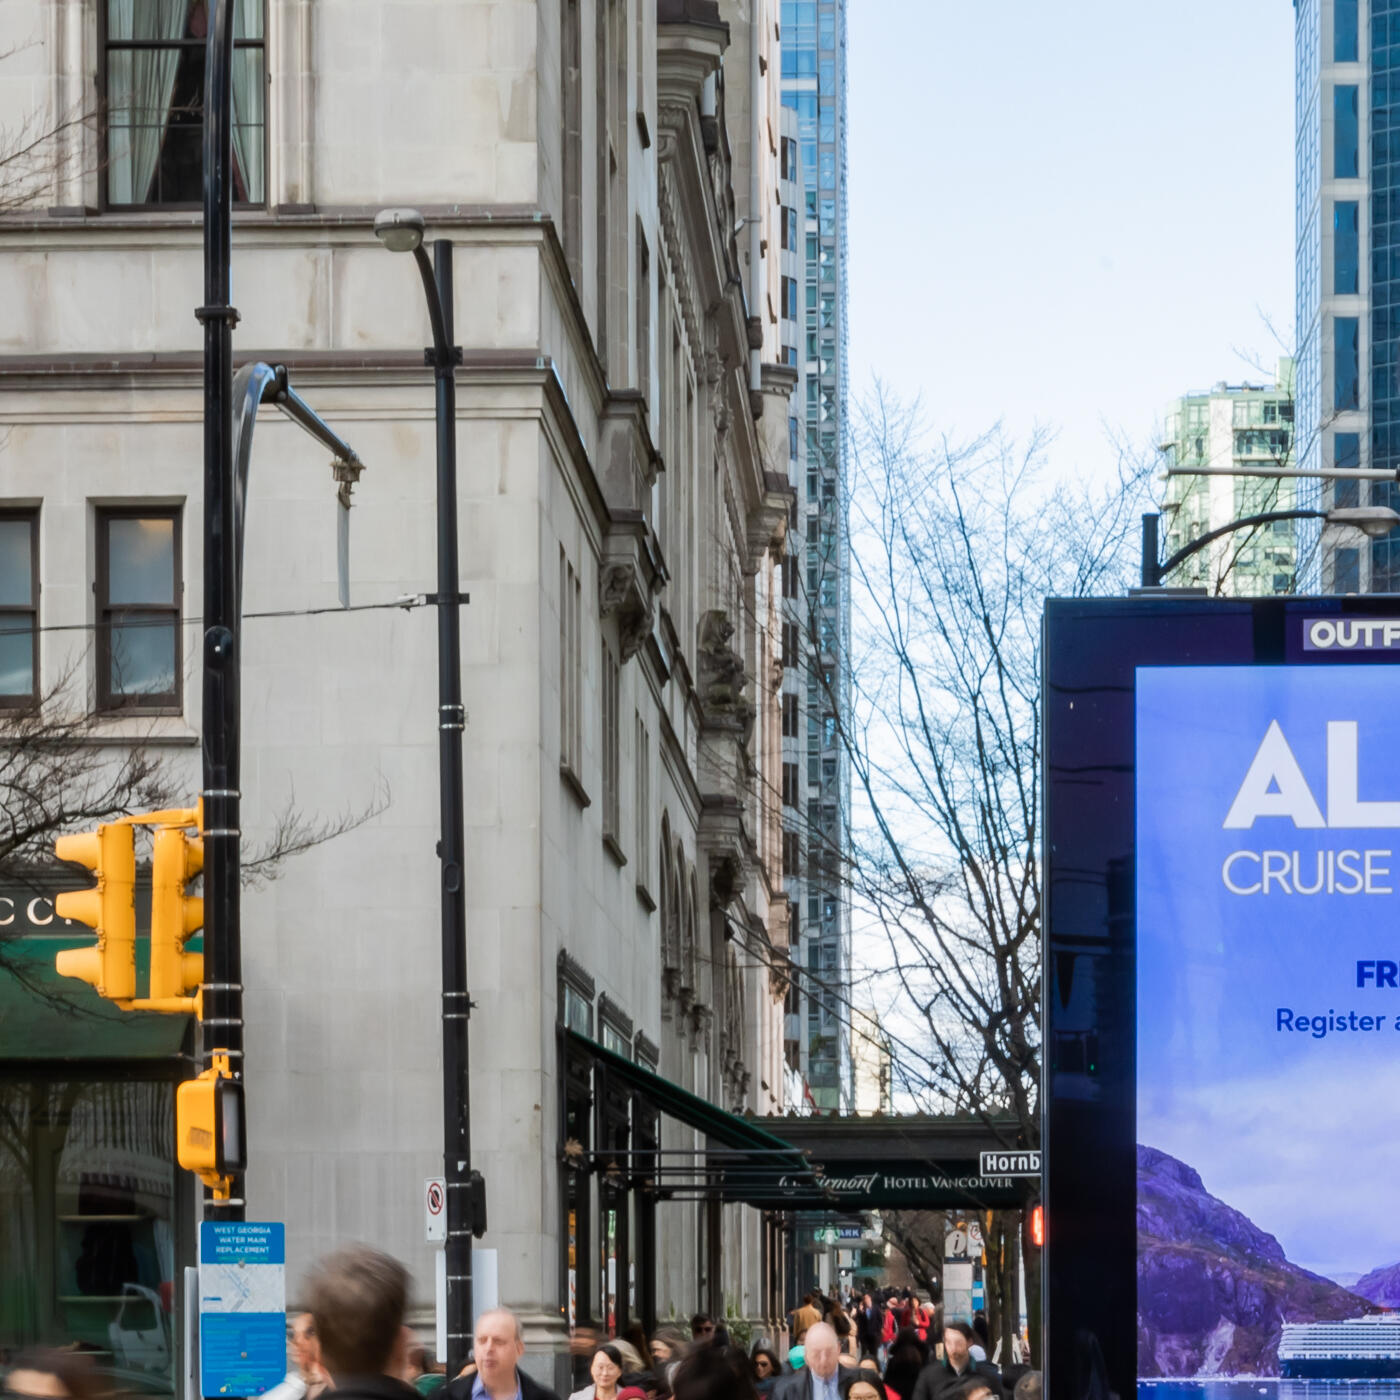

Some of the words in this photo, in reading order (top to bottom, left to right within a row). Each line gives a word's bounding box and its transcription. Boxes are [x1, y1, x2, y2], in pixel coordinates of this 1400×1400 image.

[1222, 850, 1392, 895] CRUISE
[1276, 1007, 1387, 1038] Register
[883, 1177, 928, 1189] HOTEL
[931, 1176, 1013, 1189] VANCOUVER
[214, 1226, 236, 1234] WEST
[237, 1226, 272, 1234] GEORGIA
[219, 1236, 246, 1244] WATER
[247, 1236, 267, 1244] MAIN
[215, 1245, 271, 1254] REPLACEMENT
